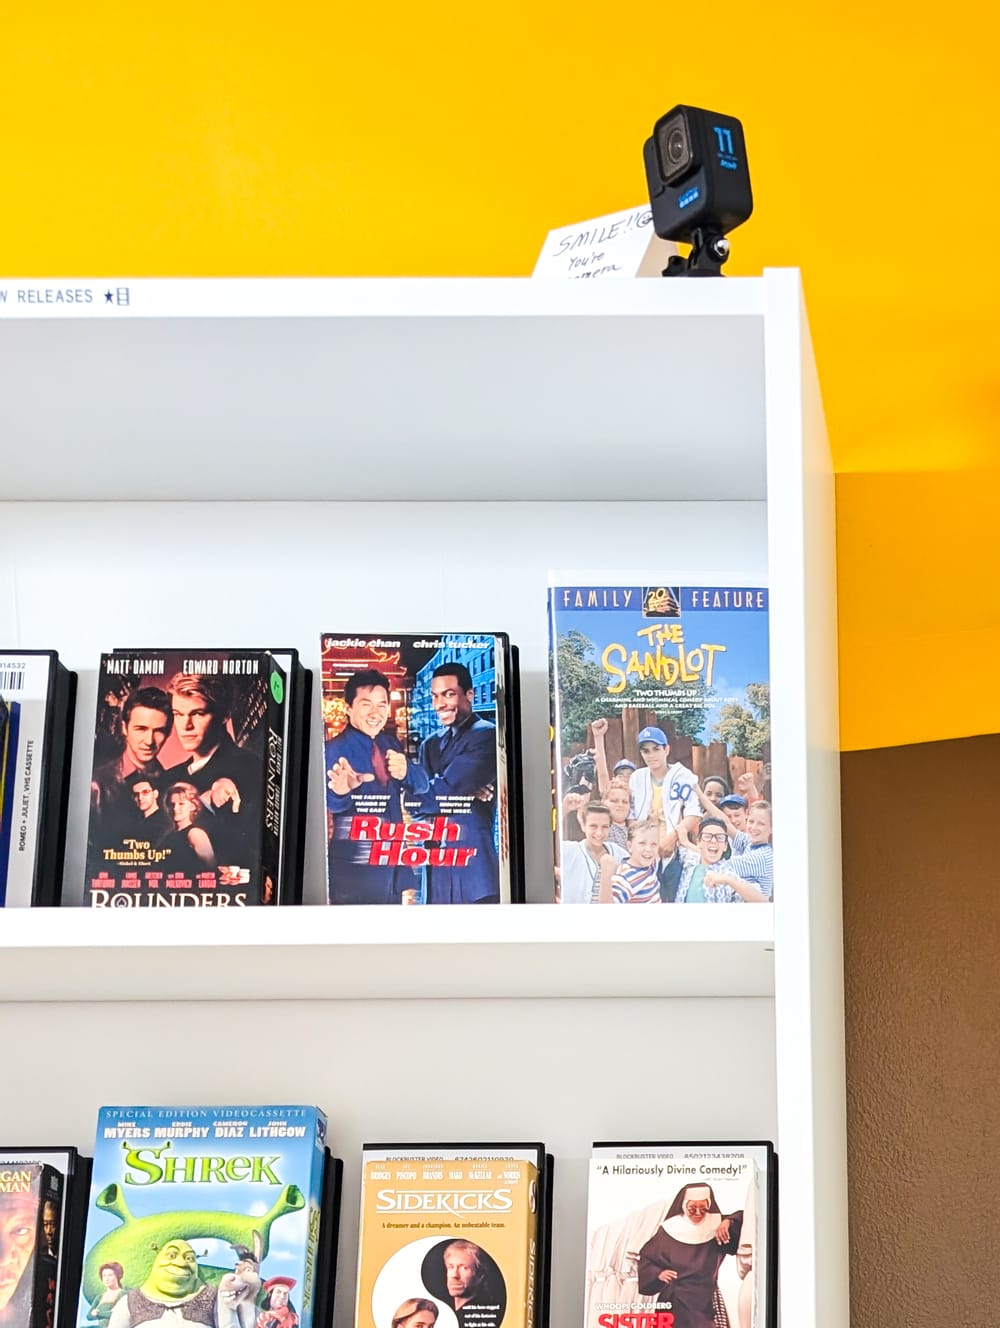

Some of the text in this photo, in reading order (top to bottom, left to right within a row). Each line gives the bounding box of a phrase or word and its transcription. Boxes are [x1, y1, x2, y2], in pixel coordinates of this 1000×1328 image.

[568, 251, 606, 271] You're
[17, 289, 94, 304] RELEASES
[563, 590, 764, 608] FAMILY FEATURE
[326, 638, 491, 649] jackie chan chris tucker
[637, 624, 685, 647] THE
[106, 660, 259, 674] MATT DAMON EDWARD NORTON
[601, 643, 728, 693] SANDLOT
[265, 728, 278, 833] ROUNDERS
[18, 825, 27, 851] ROMEO
[25, 740, 34, 776] CASSETTE
[669, 782, 694, 801] 30
[350, 815, 461, 842] Rush
[103, 850, 145, 861] Thumbs
[368, 841, 477, 867] Hour
[89, 889, 248, 908] ROUNDERS
[106, 1109, 305, 1118] SPECIAL EDITION VIDEOCASSETTE
[103, 1126, 306, 1138] MYERS MURPHY DIAZ LITHGOW
[0, 1170, 32, 1182] GAN
[613, 1164, 664, 1177] Hilariously
[666, 1164, 696, 1174] Divine
[376, 1189, 514, 1219] SIDEKICKS
[631, 1301, 673, 1310] GOLDBERG
